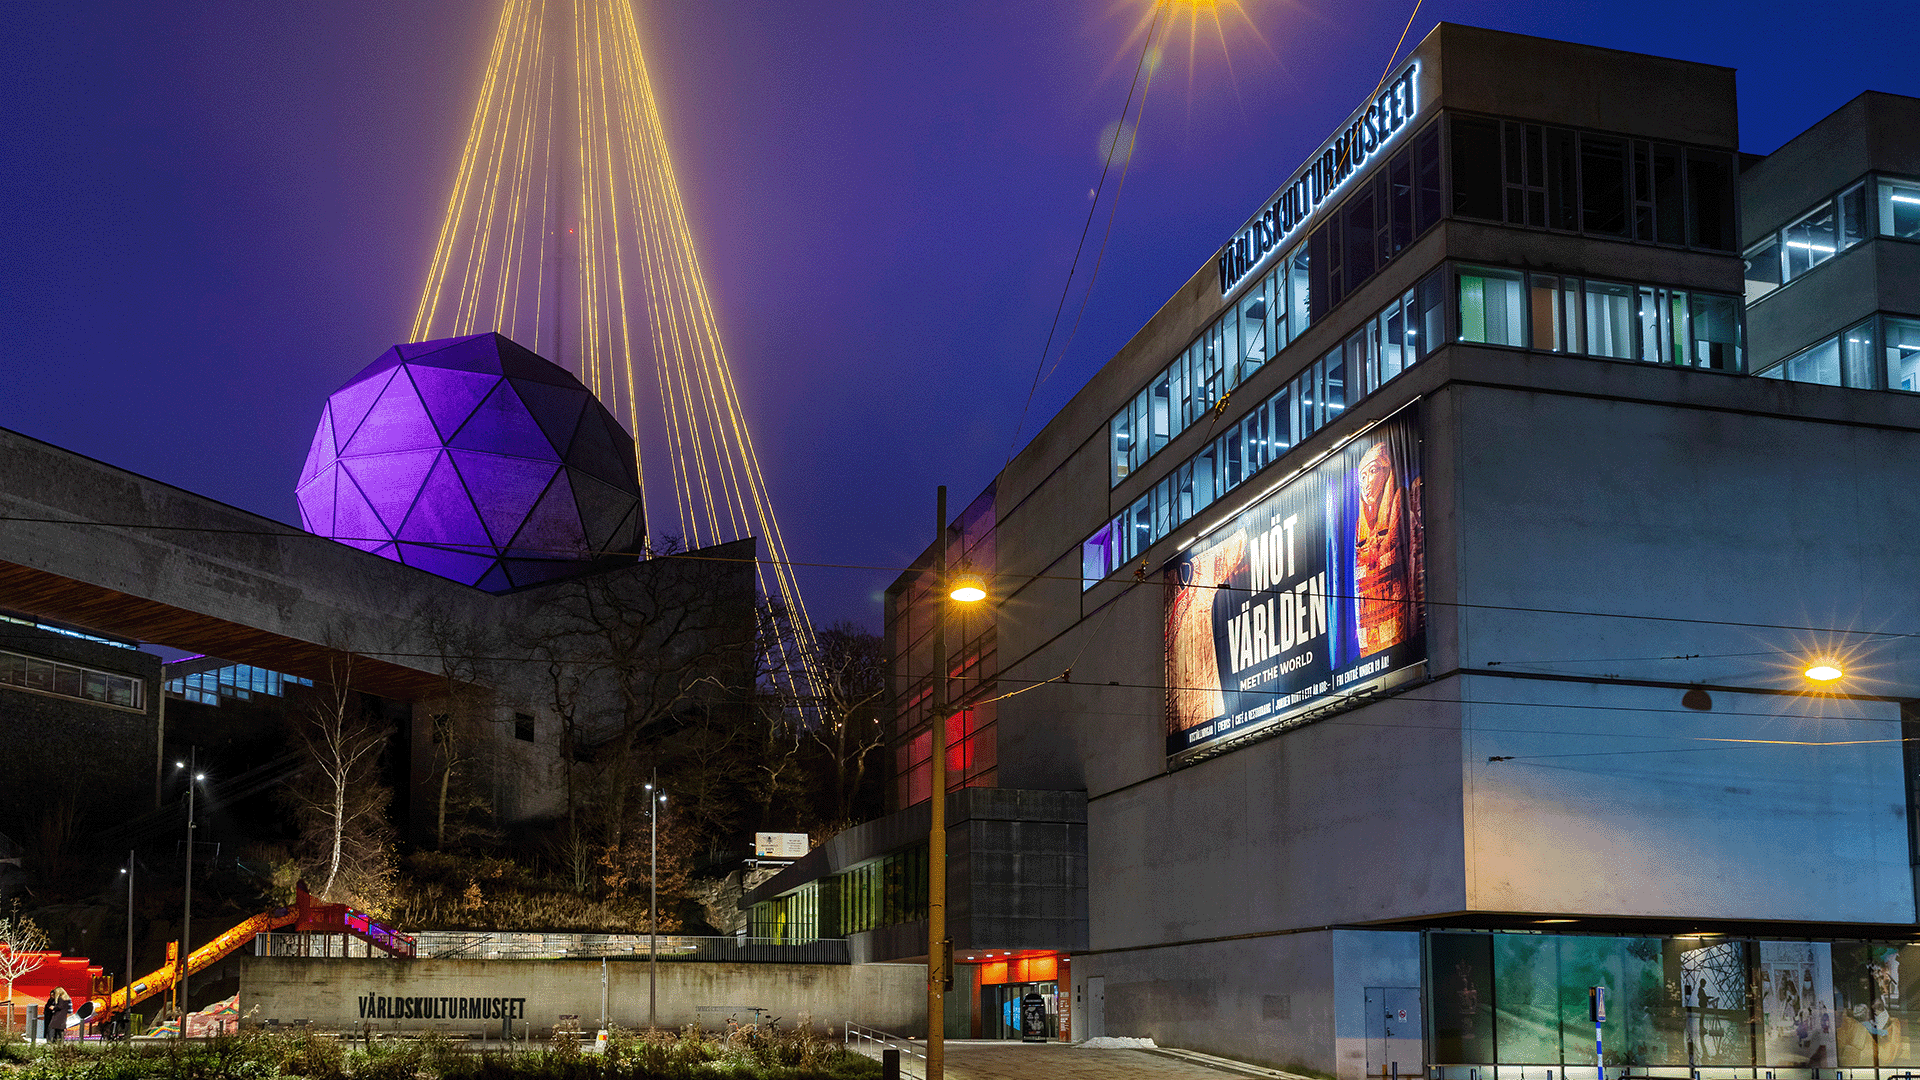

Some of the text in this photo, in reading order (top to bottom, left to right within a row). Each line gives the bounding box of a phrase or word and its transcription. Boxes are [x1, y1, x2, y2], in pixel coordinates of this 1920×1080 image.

[1219, 64, 1417, 295] VÄRLDSKULTURMUSEET
[1250, 513, 1298, 597] MÖT
[1227, 571, 1327, 674] VÄRLDEN
[1239, 651, 1313, 692] MEET THE WORLD
[358, 992, 526, 1019] VÄRLDSKULTURMUSEET
